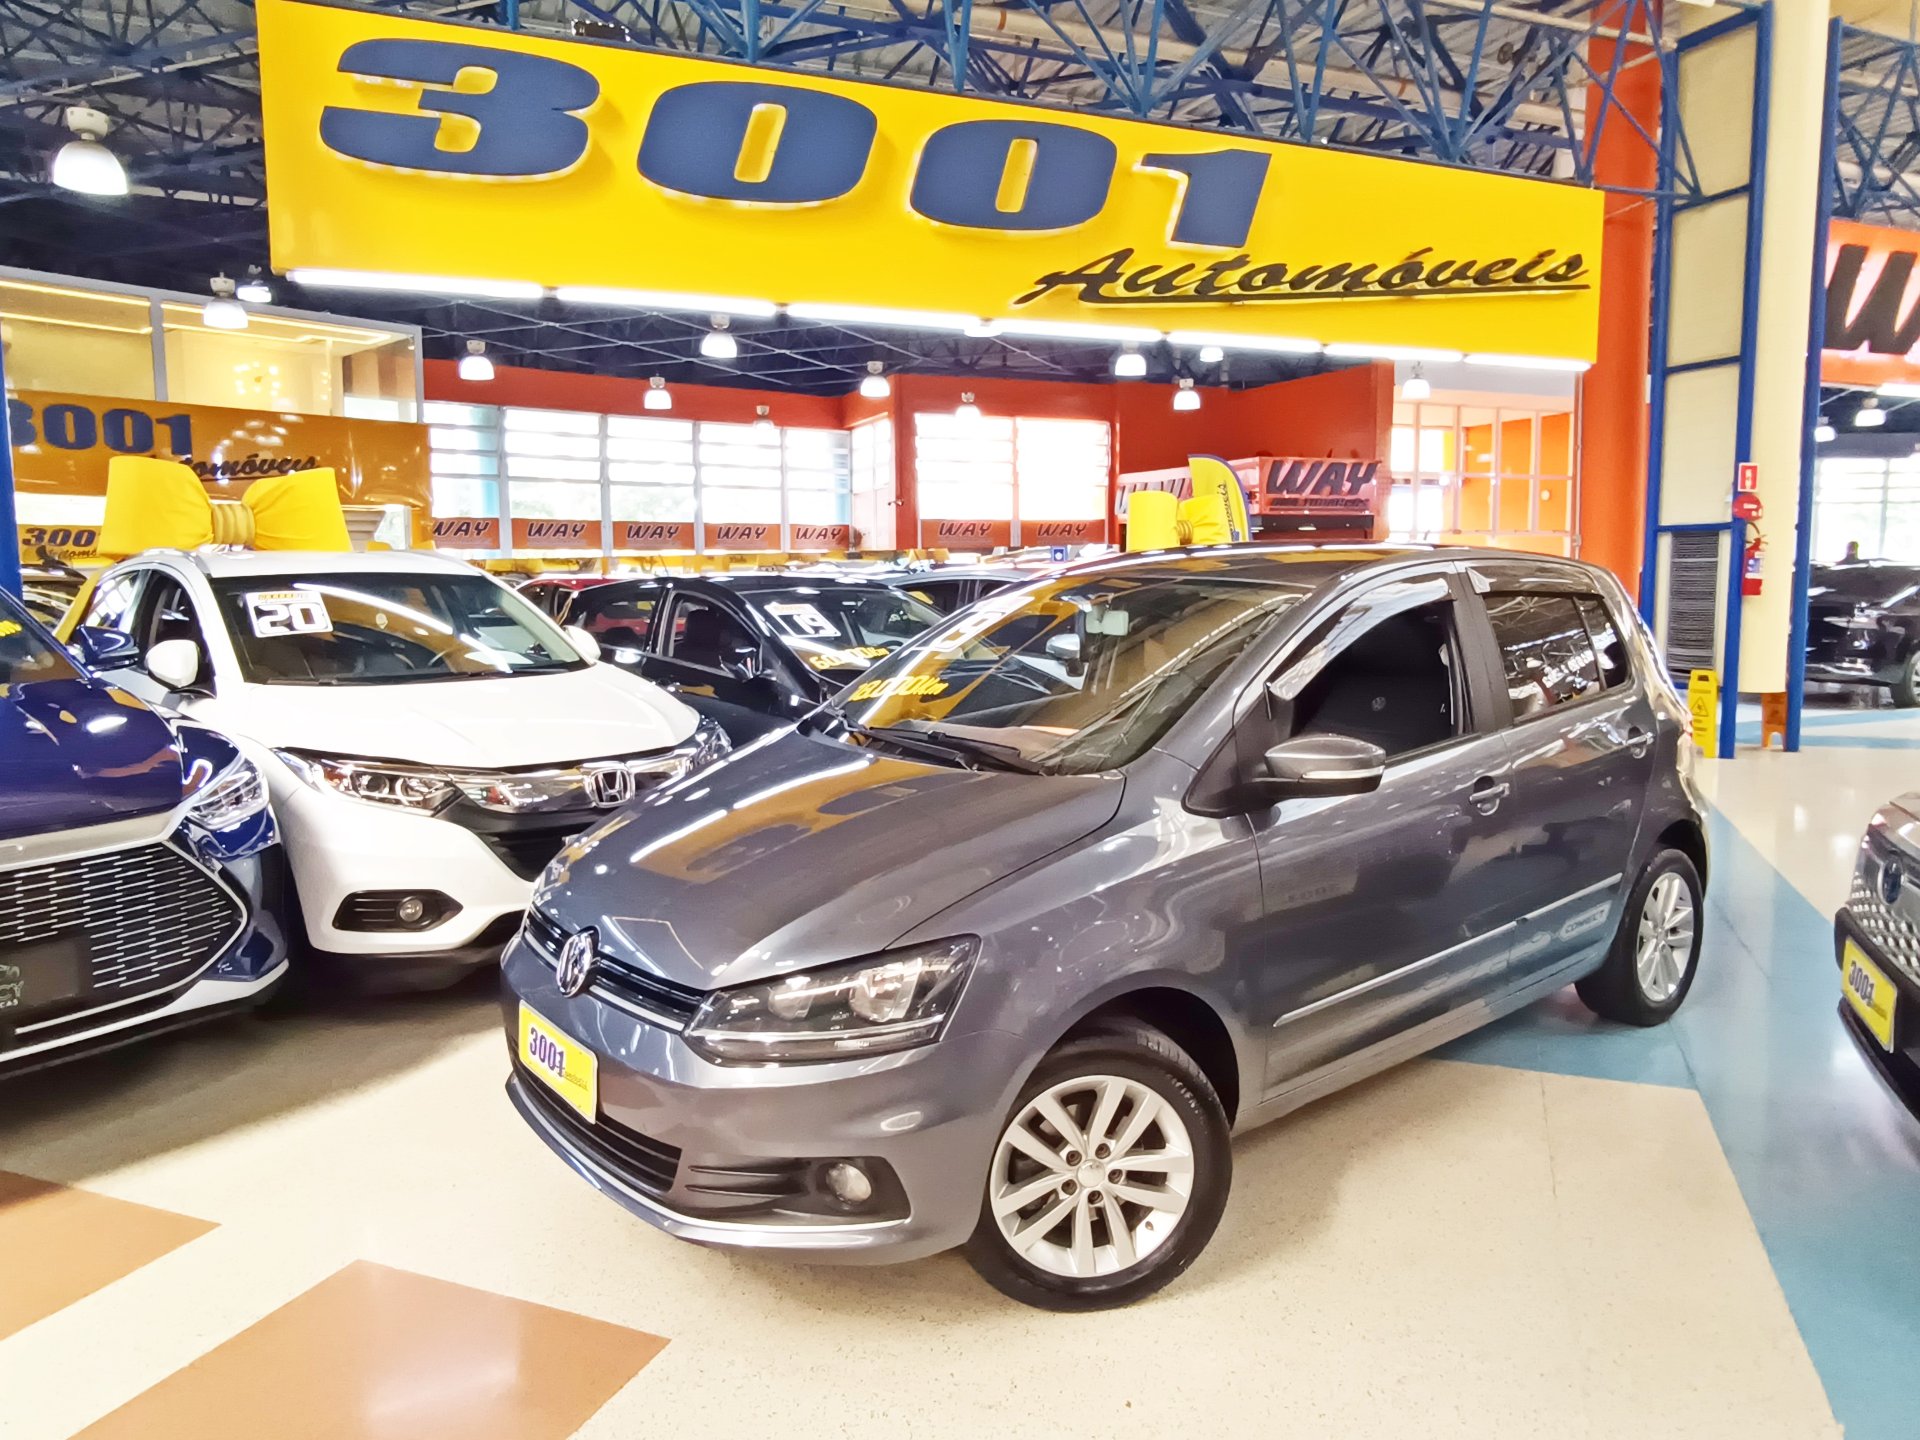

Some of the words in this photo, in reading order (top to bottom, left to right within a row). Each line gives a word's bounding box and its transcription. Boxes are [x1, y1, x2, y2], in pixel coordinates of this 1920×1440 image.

[319, 38, 1273, 250] 3001
[1013, 247, 1590, 304] Automóveis
[1265, 459, 1380, 495] WAY
[22, 528, 100, 547] 300
[527, 522, 586, 538] WAY
[626, 524, 680, 539] WAY
[716, 525, 768, 540] WAY
[795, 526, 843, 541] WAY
[938, 521, 994, 537] WAY
[1036, 522, 1087, 538] WAY
[257, 603, 325, 632] 20
[530, 1027, 566, 1078] 3001
